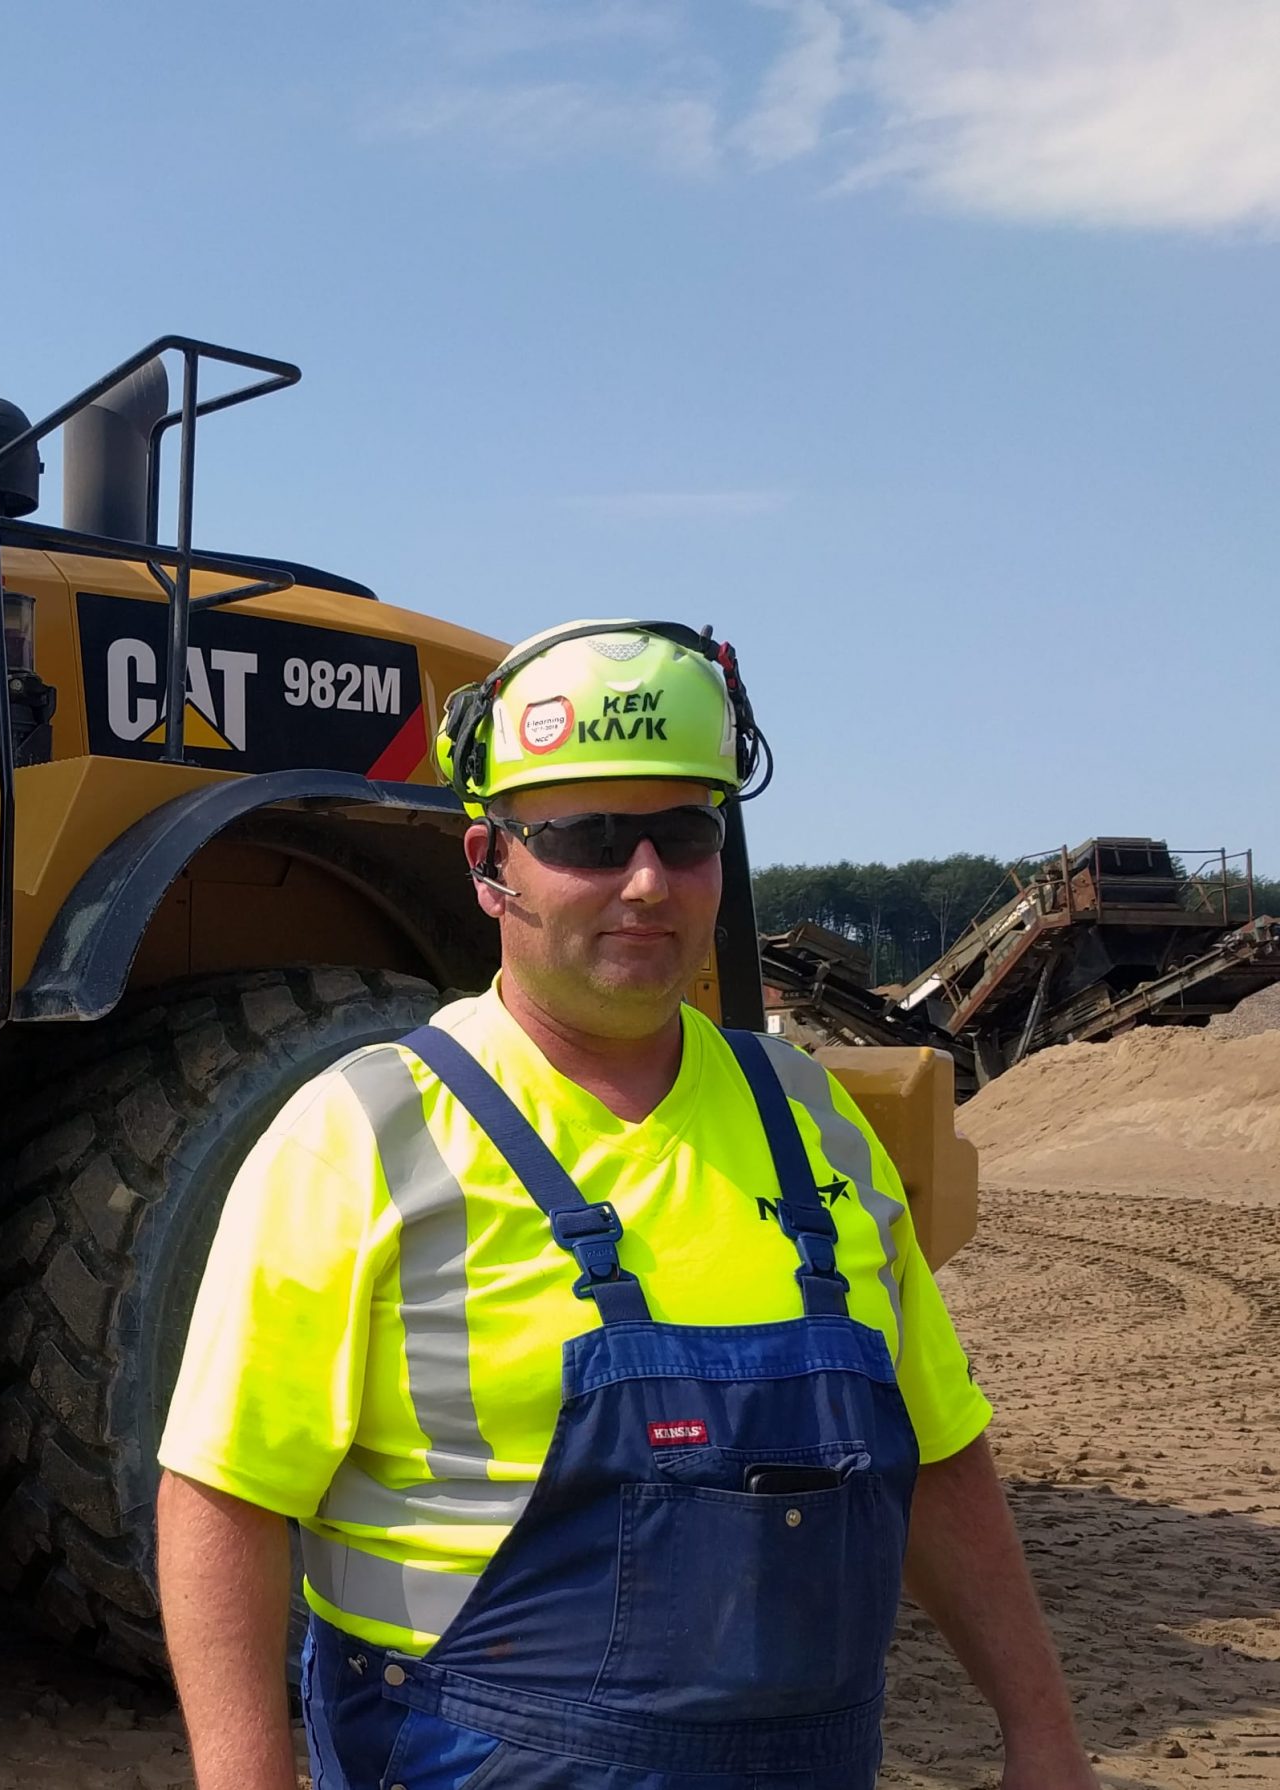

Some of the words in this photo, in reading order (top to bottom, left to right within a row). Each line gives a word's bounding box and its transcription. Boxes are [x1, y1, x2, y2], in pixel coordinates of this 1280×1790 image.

[107, 638, 258, 752] CAT
[283, 657, 401, 715] 982M
[603, 689, 664, 717] KEN
[578, 717, 668, 744] KASK
